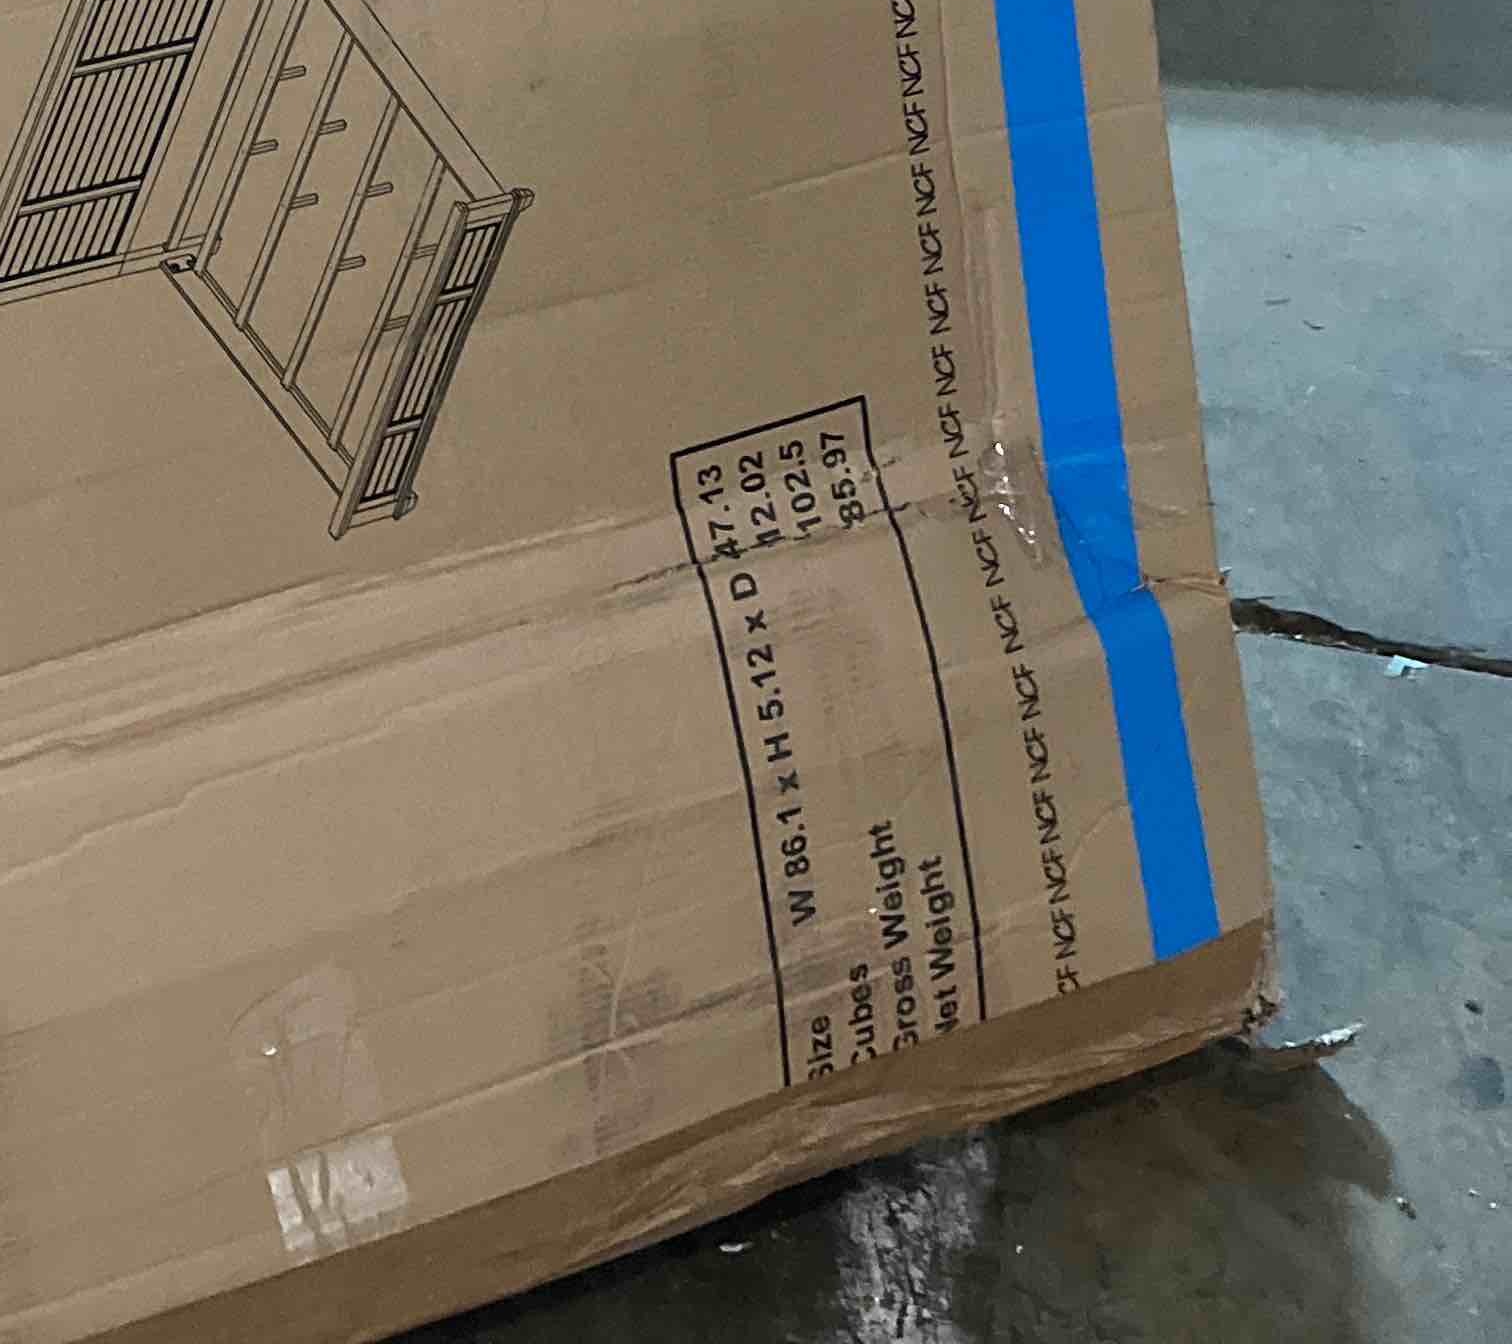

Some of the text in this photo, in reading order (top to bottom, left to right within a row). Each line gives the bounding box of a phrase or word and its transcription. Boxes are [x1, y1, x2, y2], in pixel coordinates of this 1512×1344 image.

[896, 44, 924, 98] NCF
[903, 102, 930, 156] NCF
[911, 163, 937, 217] NCF
[918, 222, 943, 276] NCF
[924, 282, 952, 335] NCF
[932, 344, 957, 397] NCF
[938, 402, 969, 459] NCF
[739, 452, 781, 544] 12.02
[779, 440, 821, 532] 102.5
[820, 432, 864, 524] 85.97
[697, 465, 740, 559] 47.13
[972, 528, 1004, 587] NCF
[730, 573, 758, 600] D
[744, 613, 765, 633] x
[990, 595, 1024, 654] NCF
[747, 647, 782, 720] 5.12
[1012, 664, 1041, 721] NCF
[765, 734, 791, 762] H
[1024, 728, 1051, 784] NCF
[777, 771, 796, 791] x
[776, 807, 809, 877] 86.1
[789, 890, 816, 927] W
[868, 820, 909, 949] Weight
[918, 856, 955, 980] Weight
